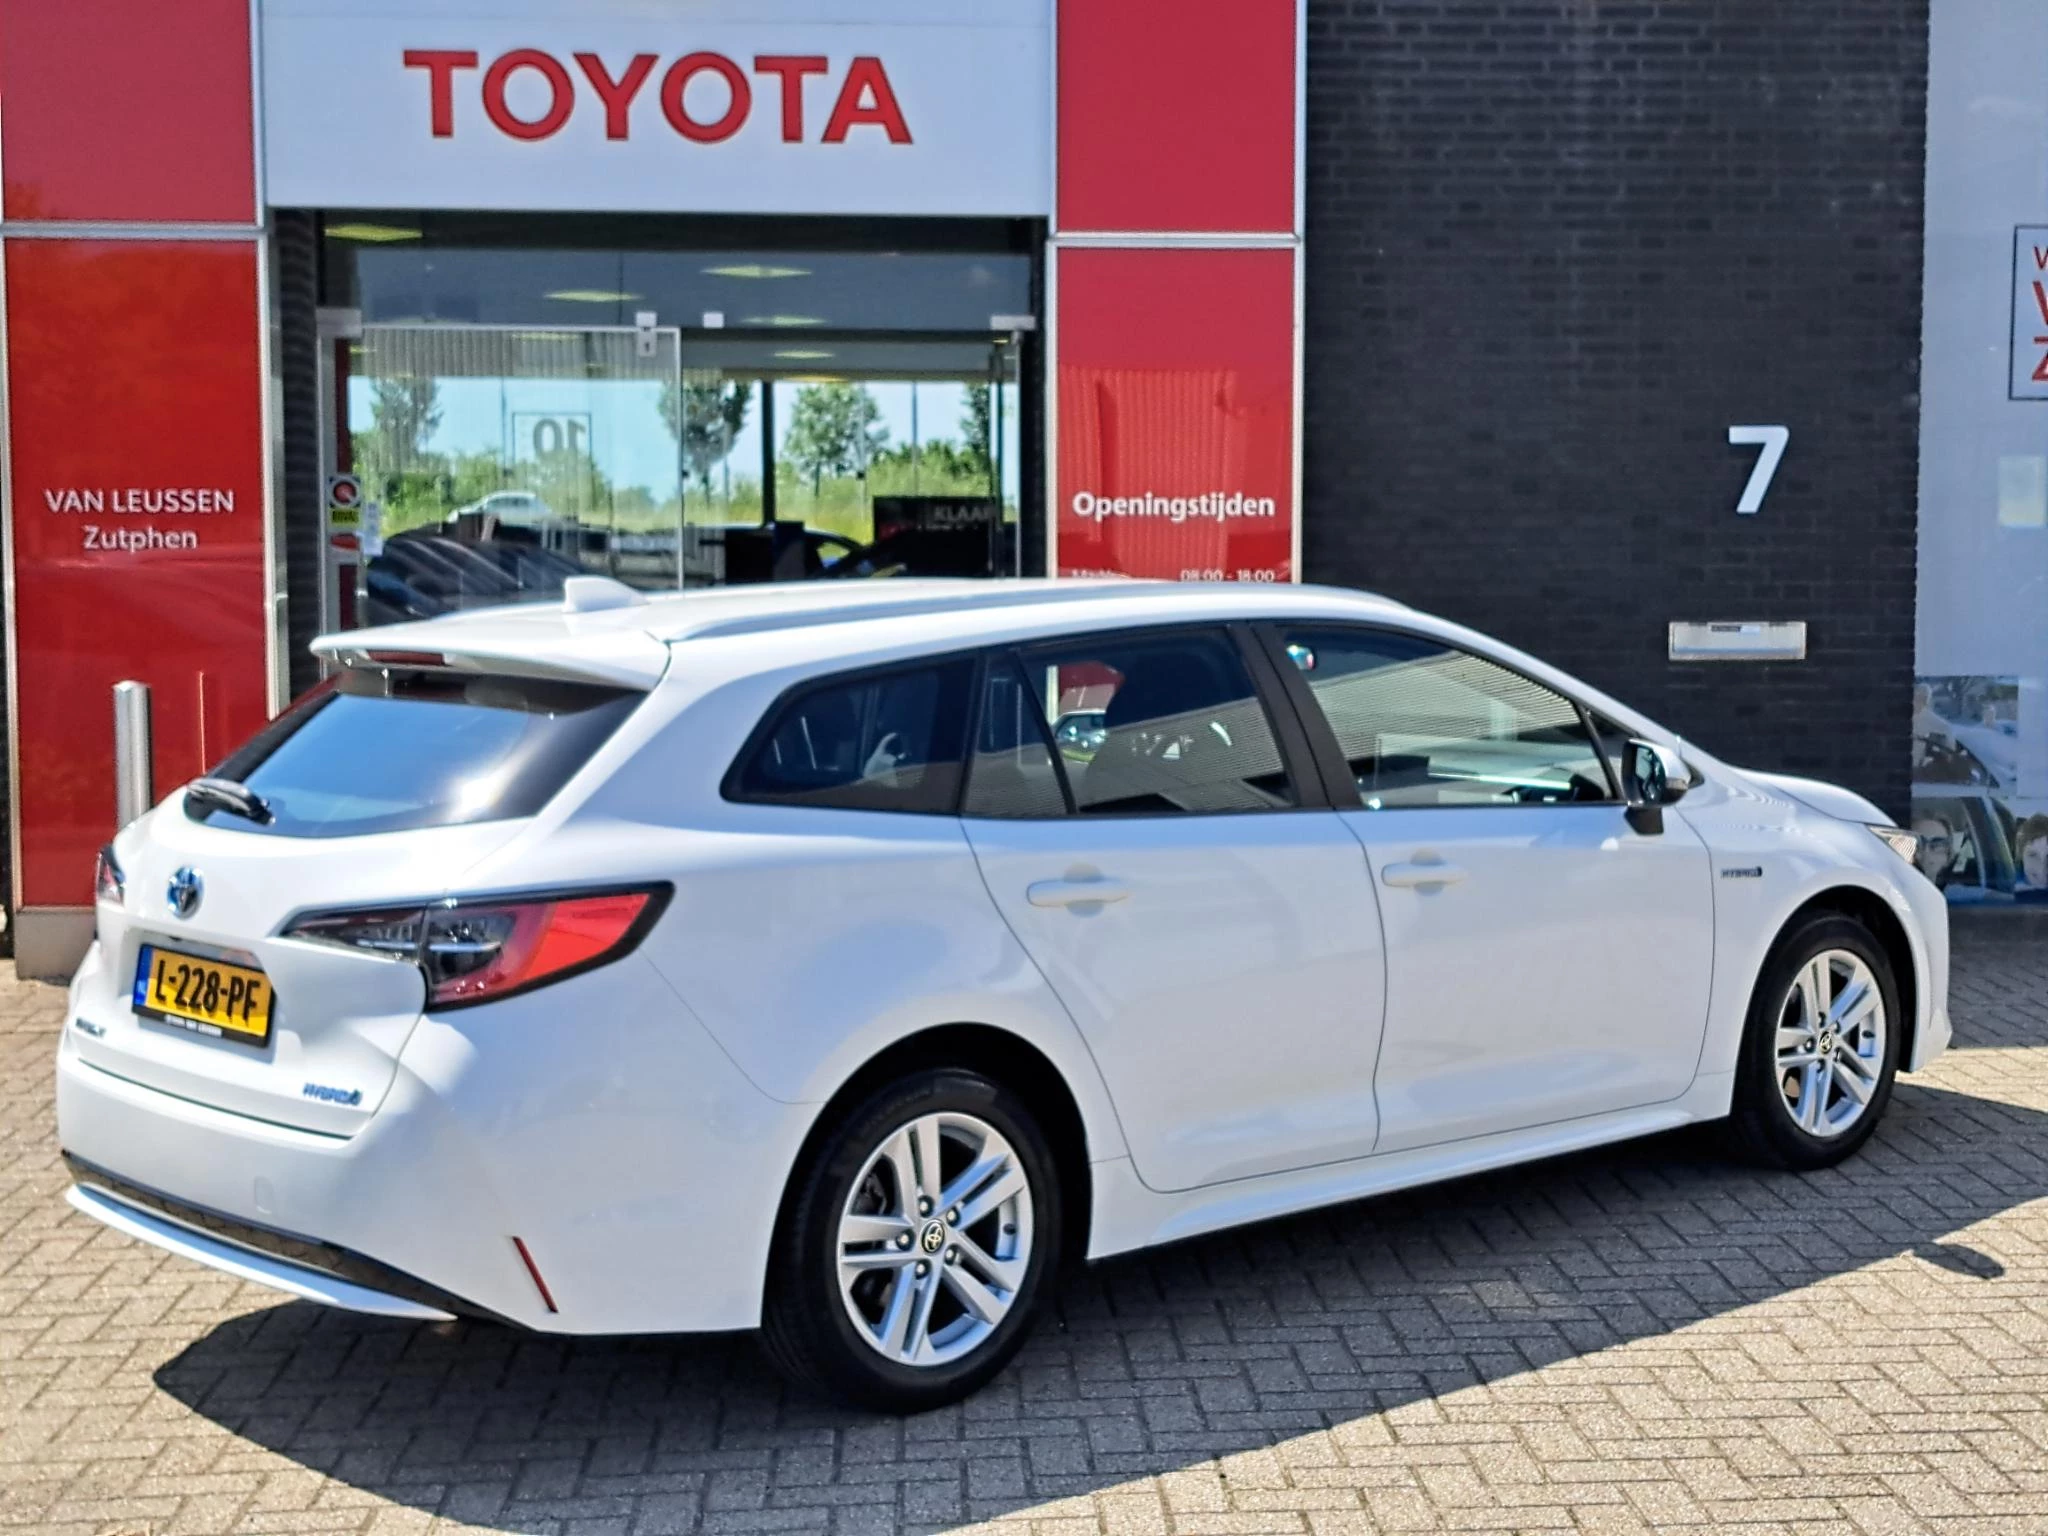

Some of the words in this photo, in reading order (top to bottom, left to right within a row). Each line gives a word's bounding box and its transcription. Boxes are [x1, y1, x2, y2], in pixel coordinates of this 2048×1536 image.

[403, 48, 914, 144] TOYOTA
[1728, 425, 1790, 514] 7
[44, 488, 105, 513] VAN
[112, 488, 235, 513] LEUSSEN
[1072, 491, 1276, 524] Openingstijden
[82, 525, 198, 554] Zutphen
[155, 959, 262, 1022] L-228-PF
